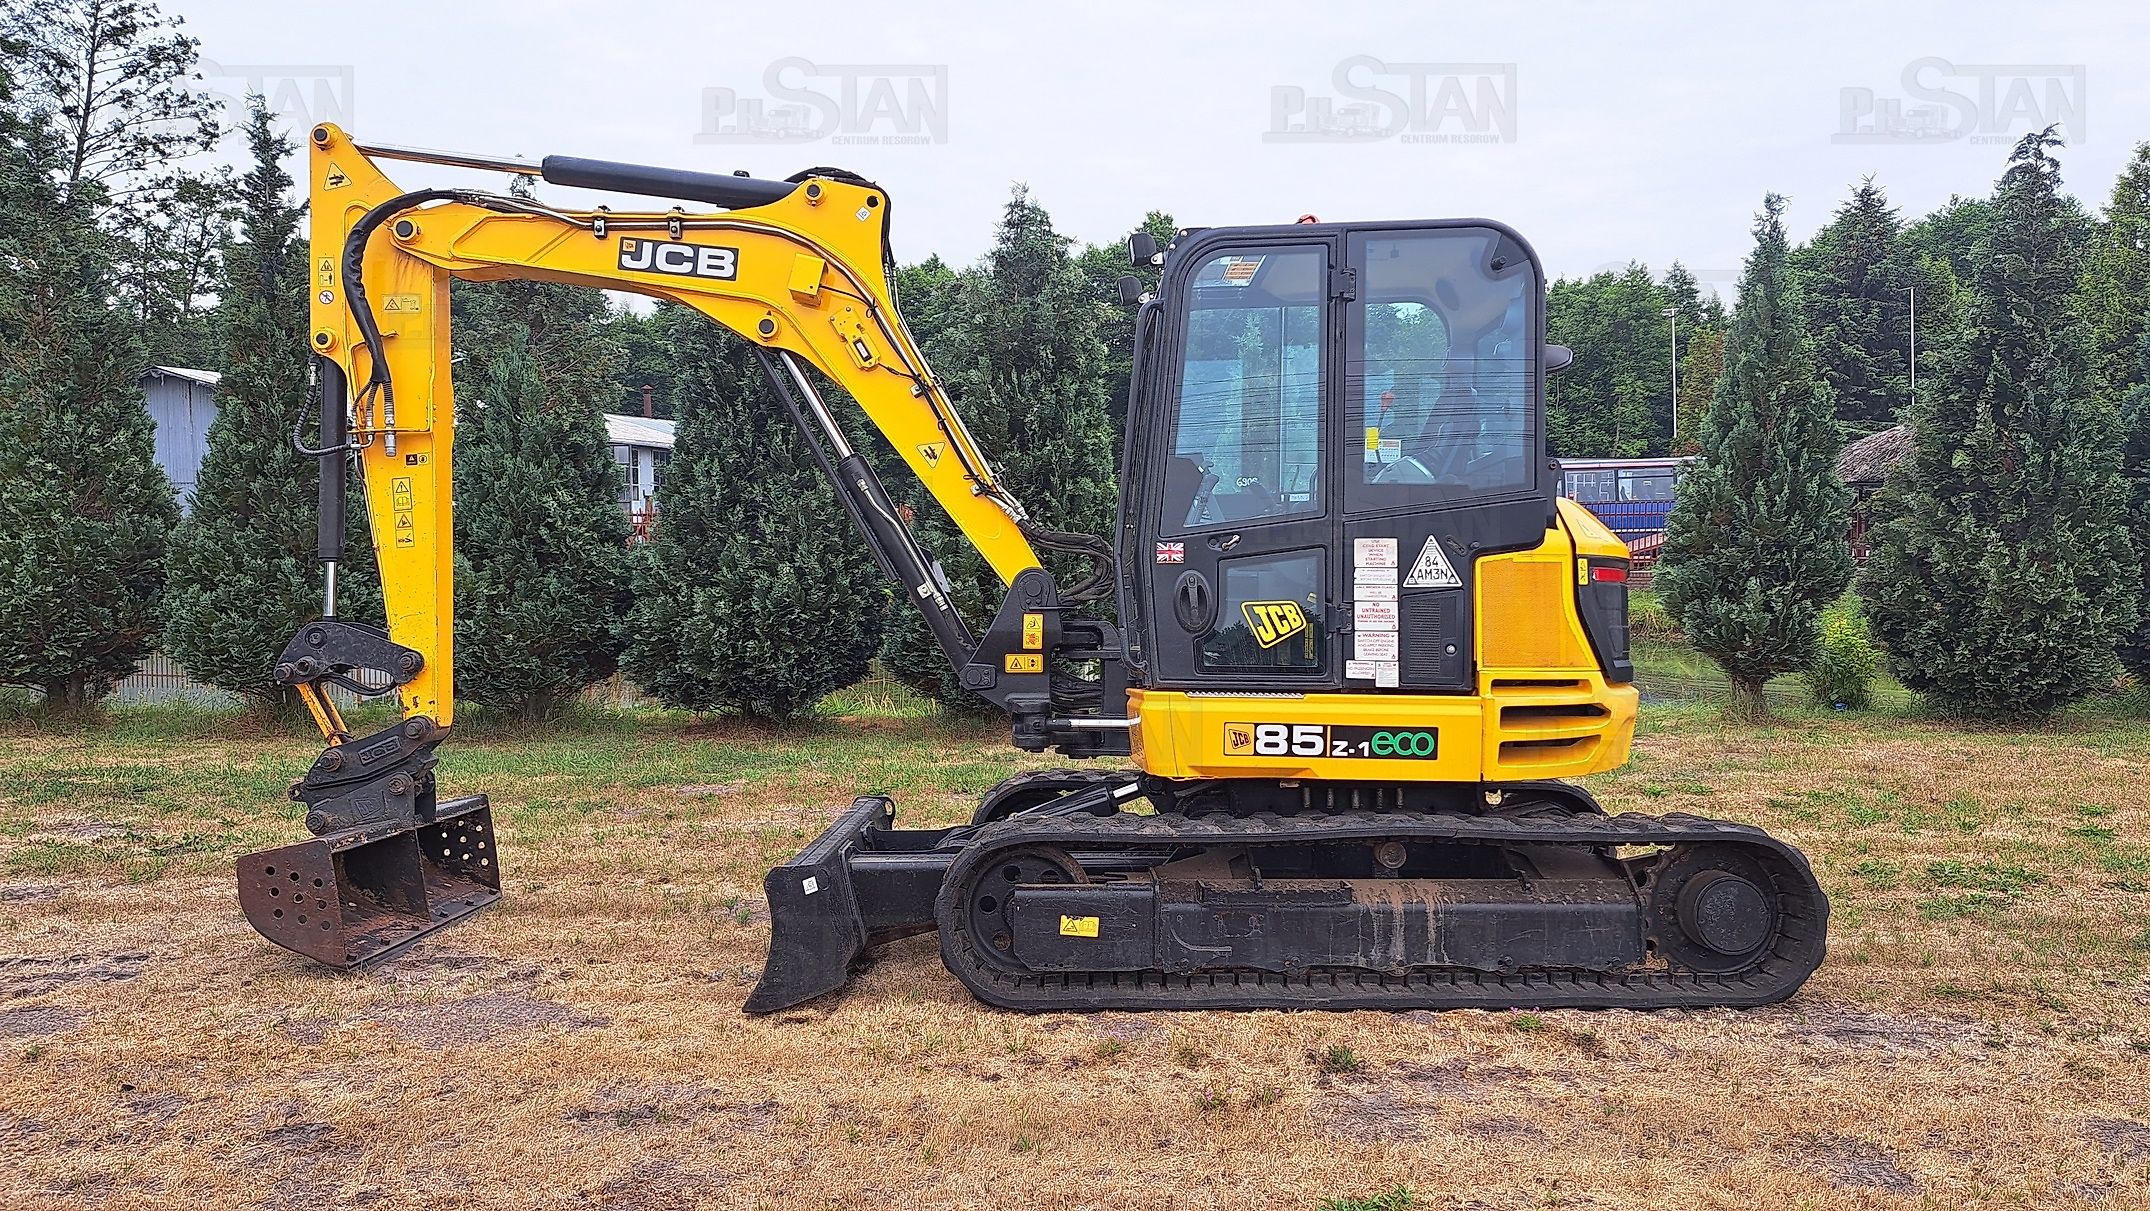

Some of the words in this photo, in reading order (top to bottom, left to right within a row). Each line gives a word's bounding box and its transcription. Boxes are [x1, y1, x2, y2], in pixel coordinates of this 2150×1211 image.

[621, 241, 735, 278] JCB
[1417, 568, 1448, 580] AM3N
[1425, 555, 1439, 567] 84
[1252, 604, 1303, 643] JCB
[1232, 731, 1250, 747] JCB
[1255, 724, 1324, 756] 85
[1371, 731, 1435, 756] eco
